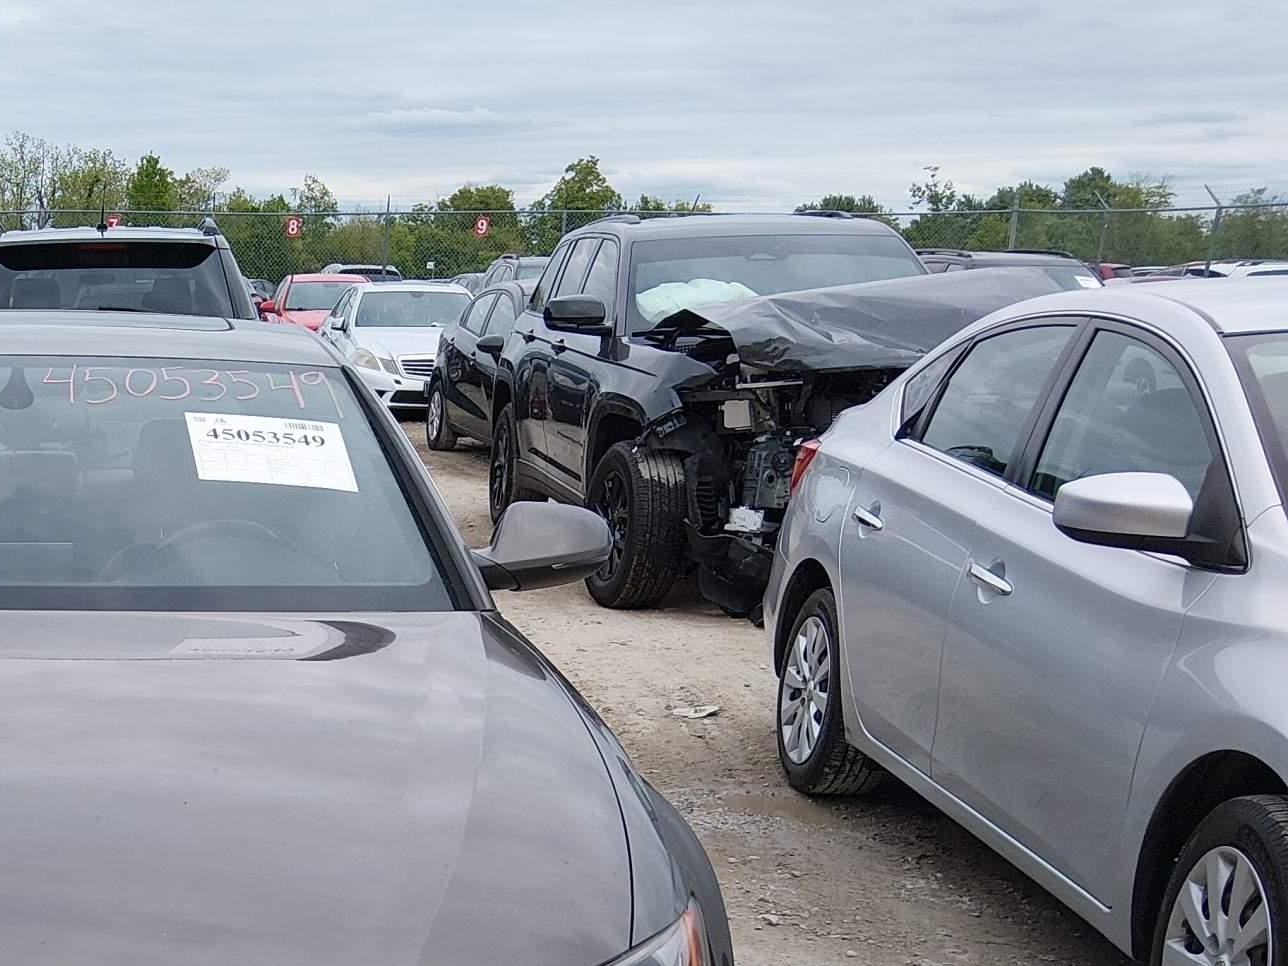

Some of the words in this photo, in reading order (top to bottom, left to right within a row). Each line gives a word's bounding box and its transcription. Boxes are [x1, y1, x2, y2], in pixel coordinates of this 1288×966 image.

[109, 218, 118, 228] 7
[289, 219, 298, 235] 8
[478, 219, 487, 234] 9
[43, 364, 344, 419] 45053549
[206, 427, 326, 448] 45053549
